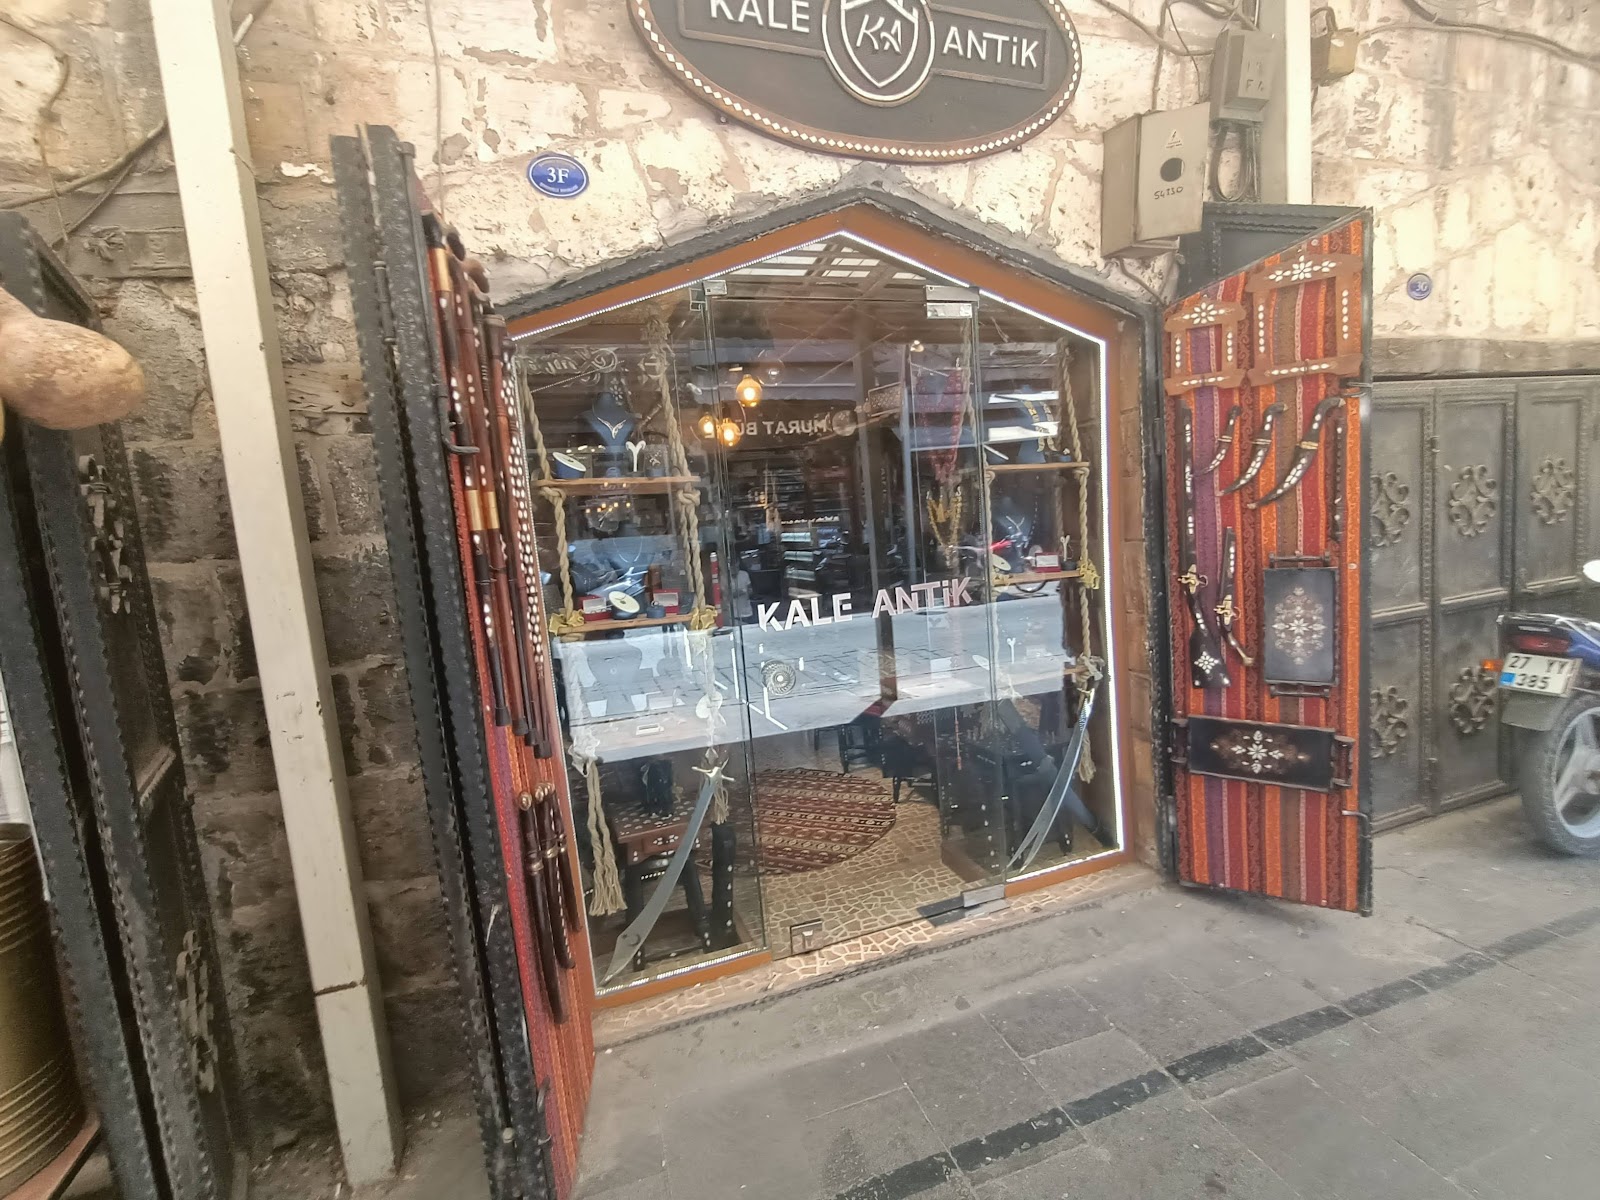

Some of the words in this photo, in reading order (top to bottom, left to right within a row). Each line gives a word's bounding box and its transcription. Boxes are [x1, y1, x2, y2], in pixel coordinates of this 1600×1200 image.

[709, 0, 810, 33] KALE
[546, 166, 570, 184] 3F
[757, 592, 853, 633] KALE
[1508, 655, 1532, 669] 27
[1545, 659, 1570, 675] YY
[1515, 673, 1552, 690] 385
